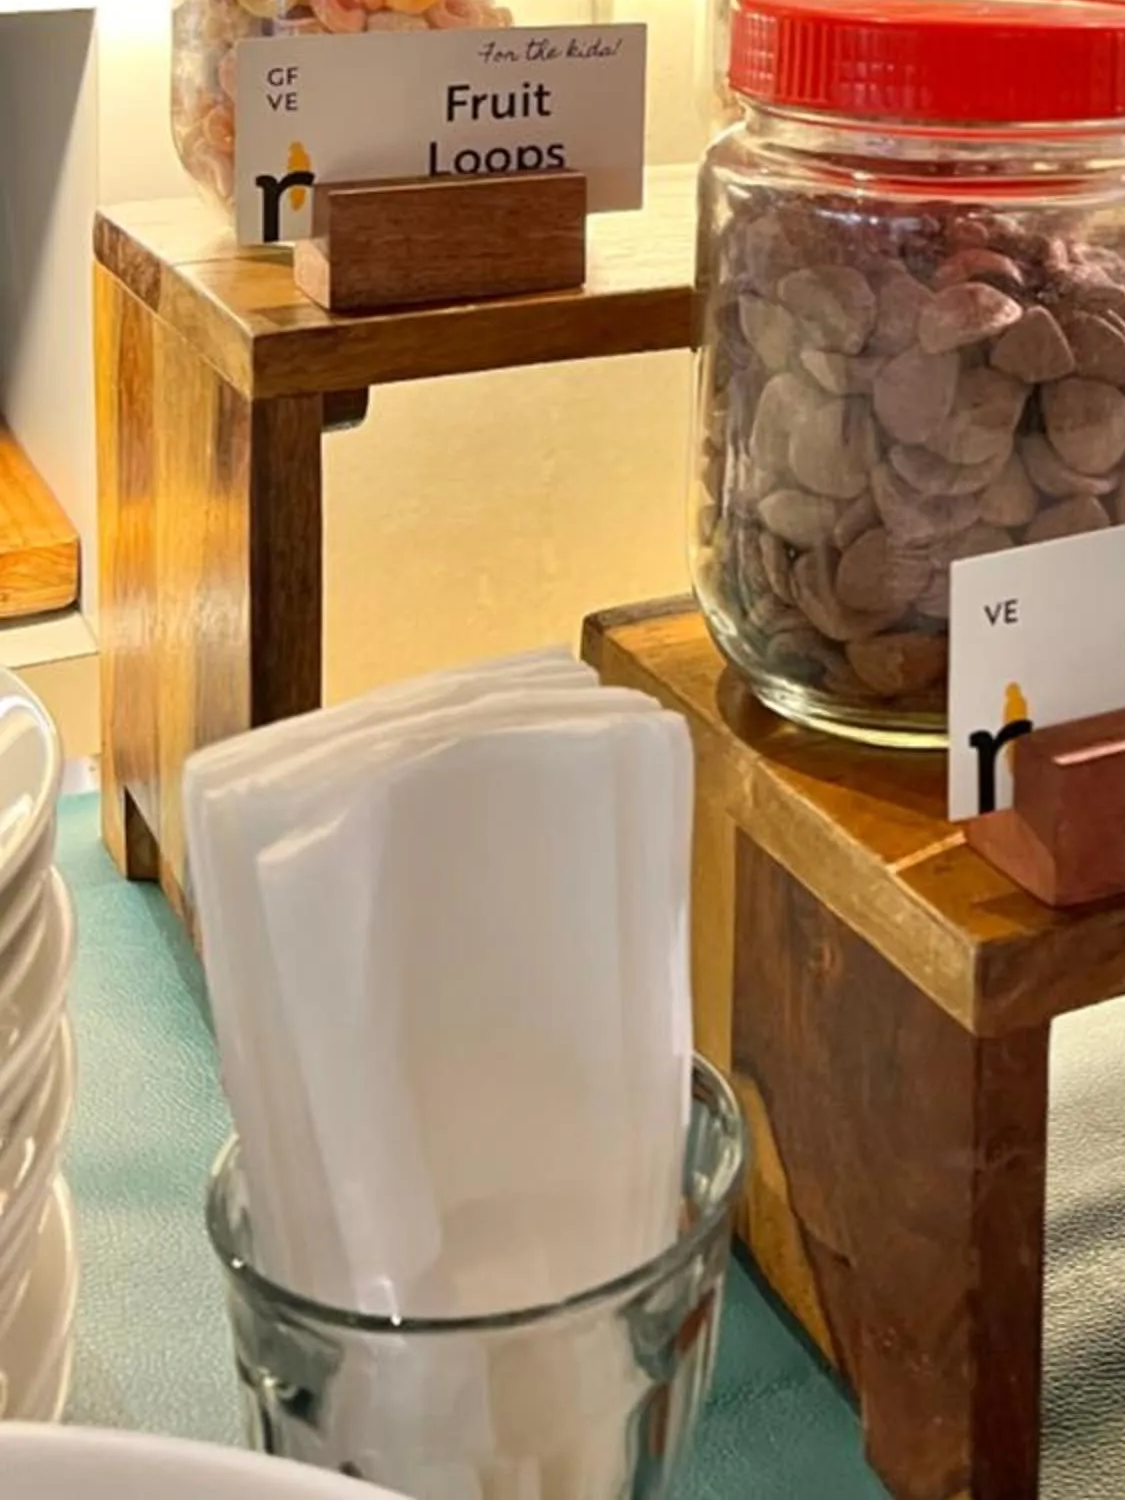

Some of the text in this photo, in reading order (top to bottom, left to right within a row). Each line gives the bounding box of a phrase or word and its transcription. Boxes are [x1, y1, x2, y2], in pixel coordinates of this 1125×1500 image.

[525, 38, 561, 61] the
[267, 68, 297, 86] GF
[266, 94, 297, 111] VE
[446, 82, 552, 122] Fruit
[429, 141, 565, 177] Loops
[984, 600, 1018, 626] VE
